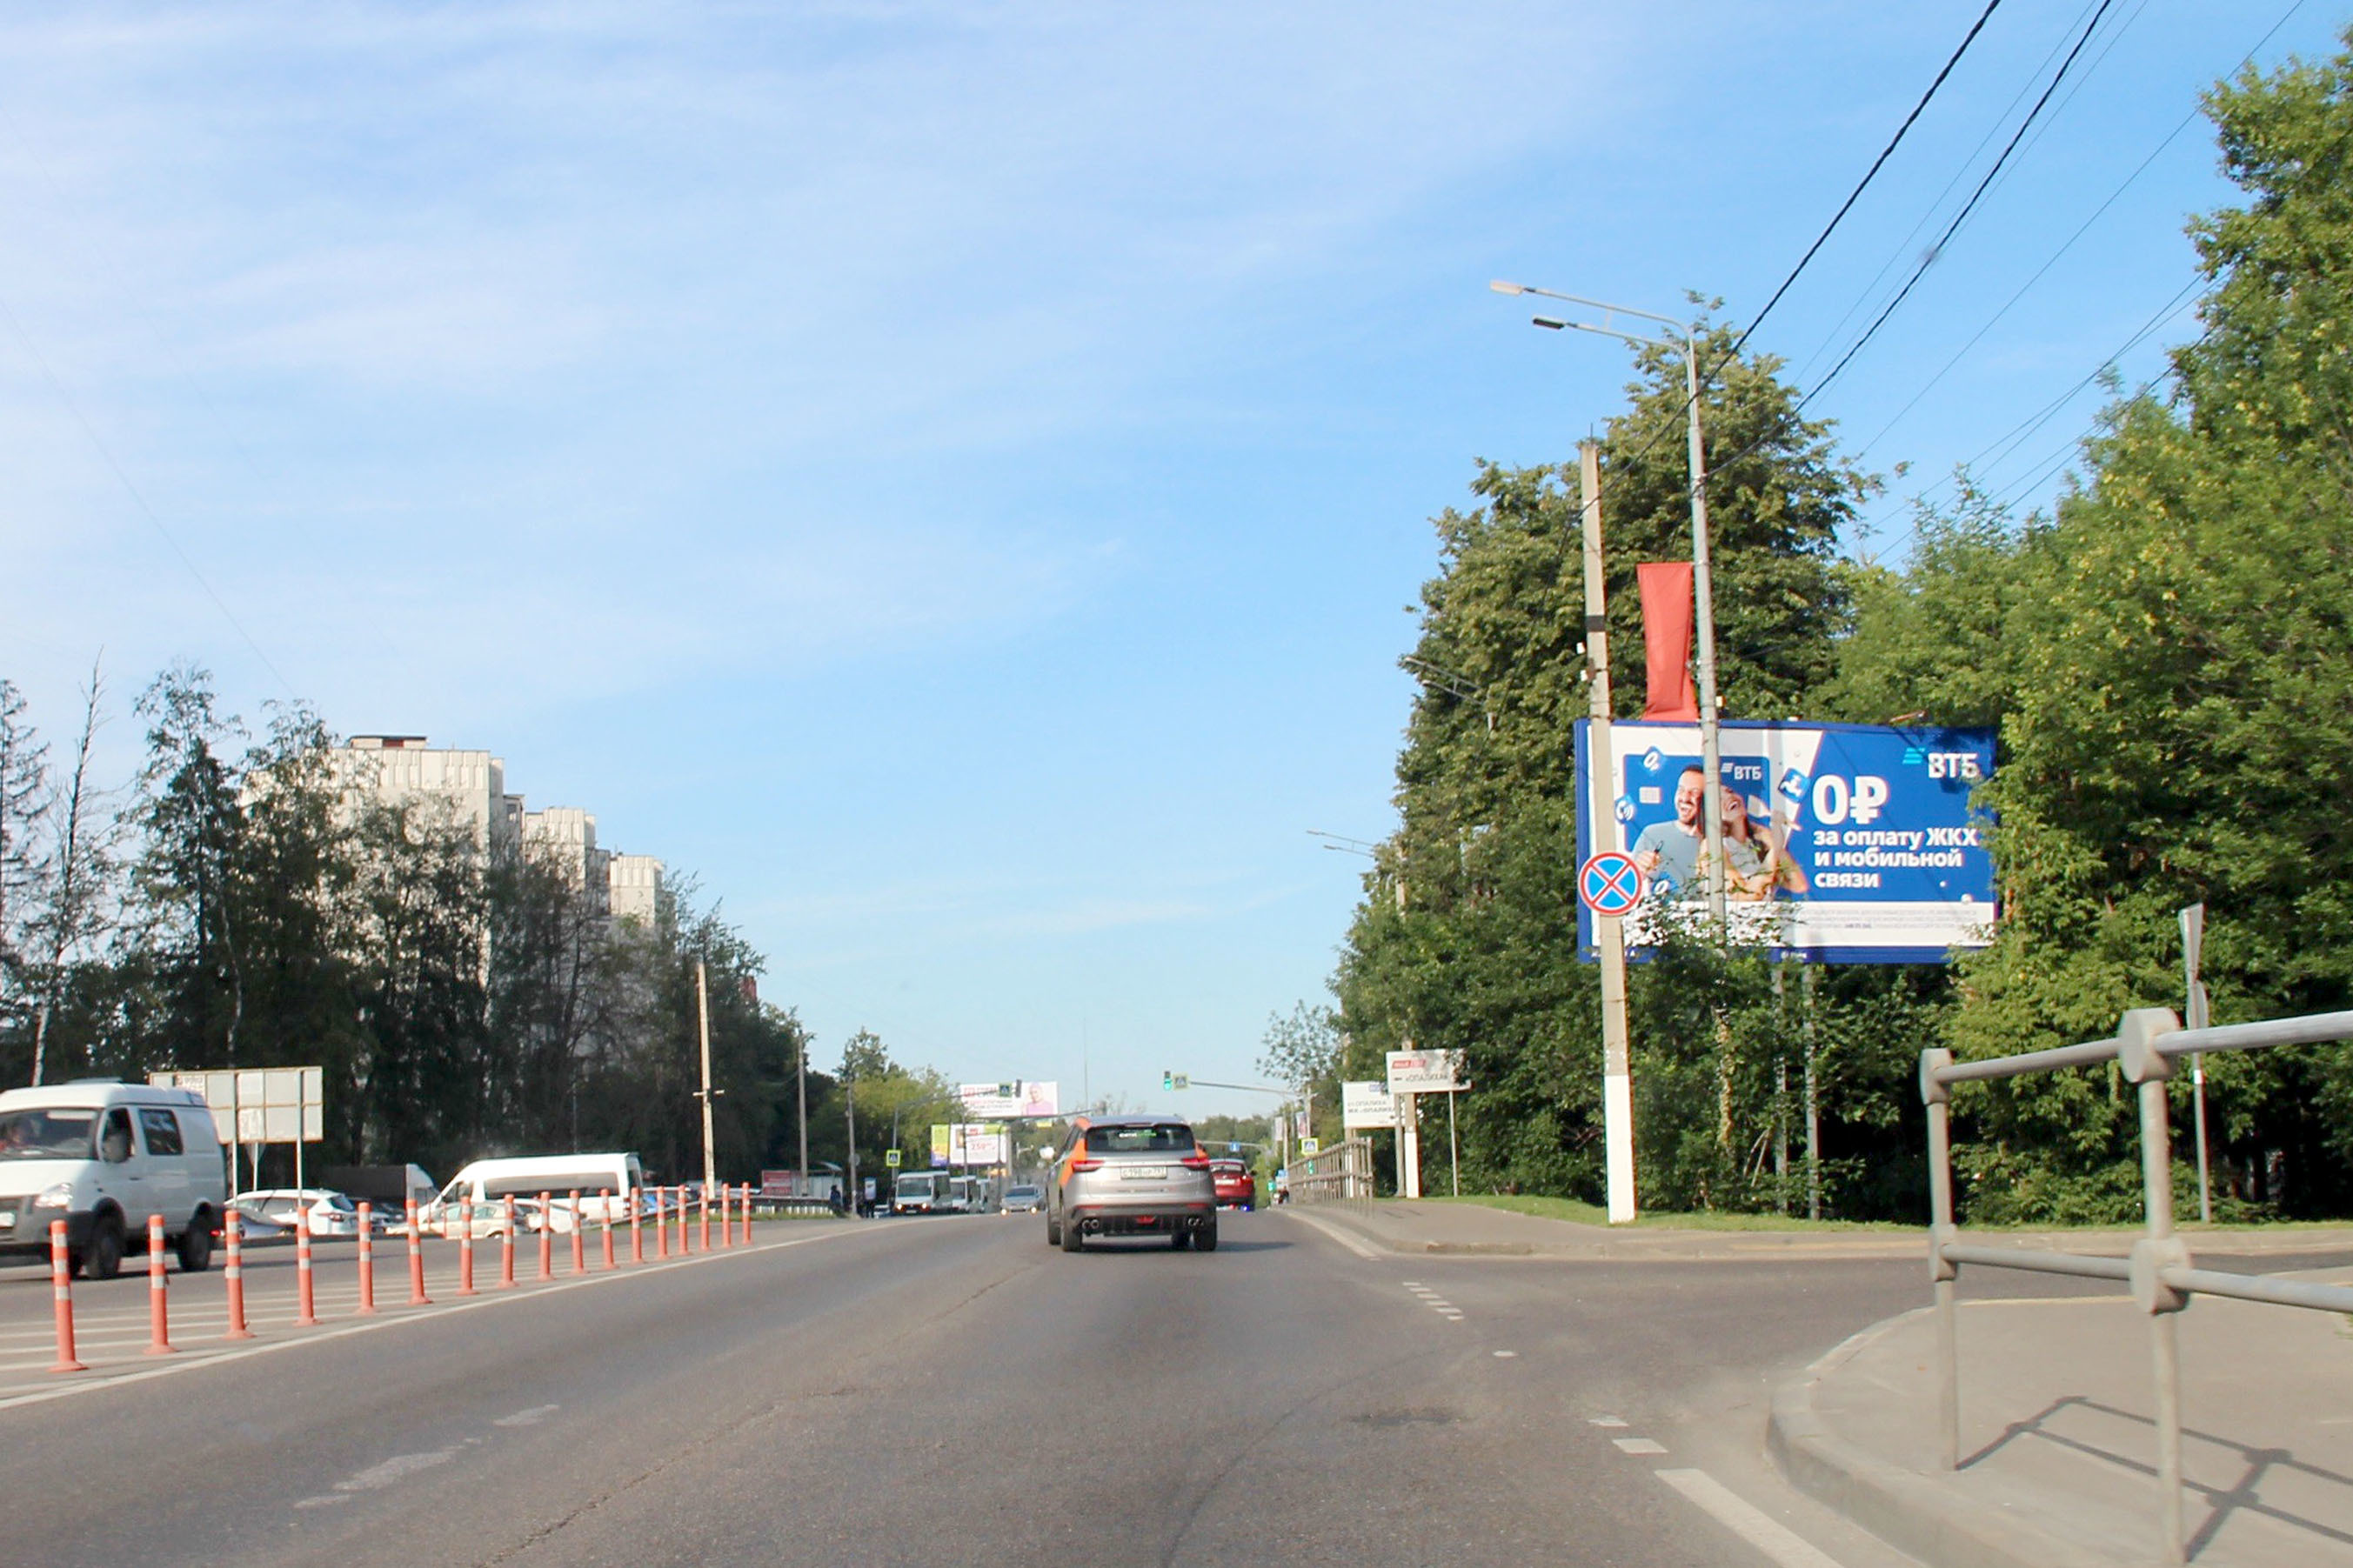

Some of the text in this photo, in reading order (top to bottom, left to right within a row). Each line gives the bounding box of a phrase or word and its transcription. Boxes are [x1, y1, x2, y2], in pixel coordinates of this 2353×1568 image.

[1734, 765, 1761, 780] ВТБ
[1928, 752, 1979, 778] ВТБ
[1813, 774, 1888, 824] 0₽
[1813, 828, 1979, 851] за оплату ЖКХ
[1815, 846, 1963, 867] и мобильной
[1815, 872, 1880, 888] связи
